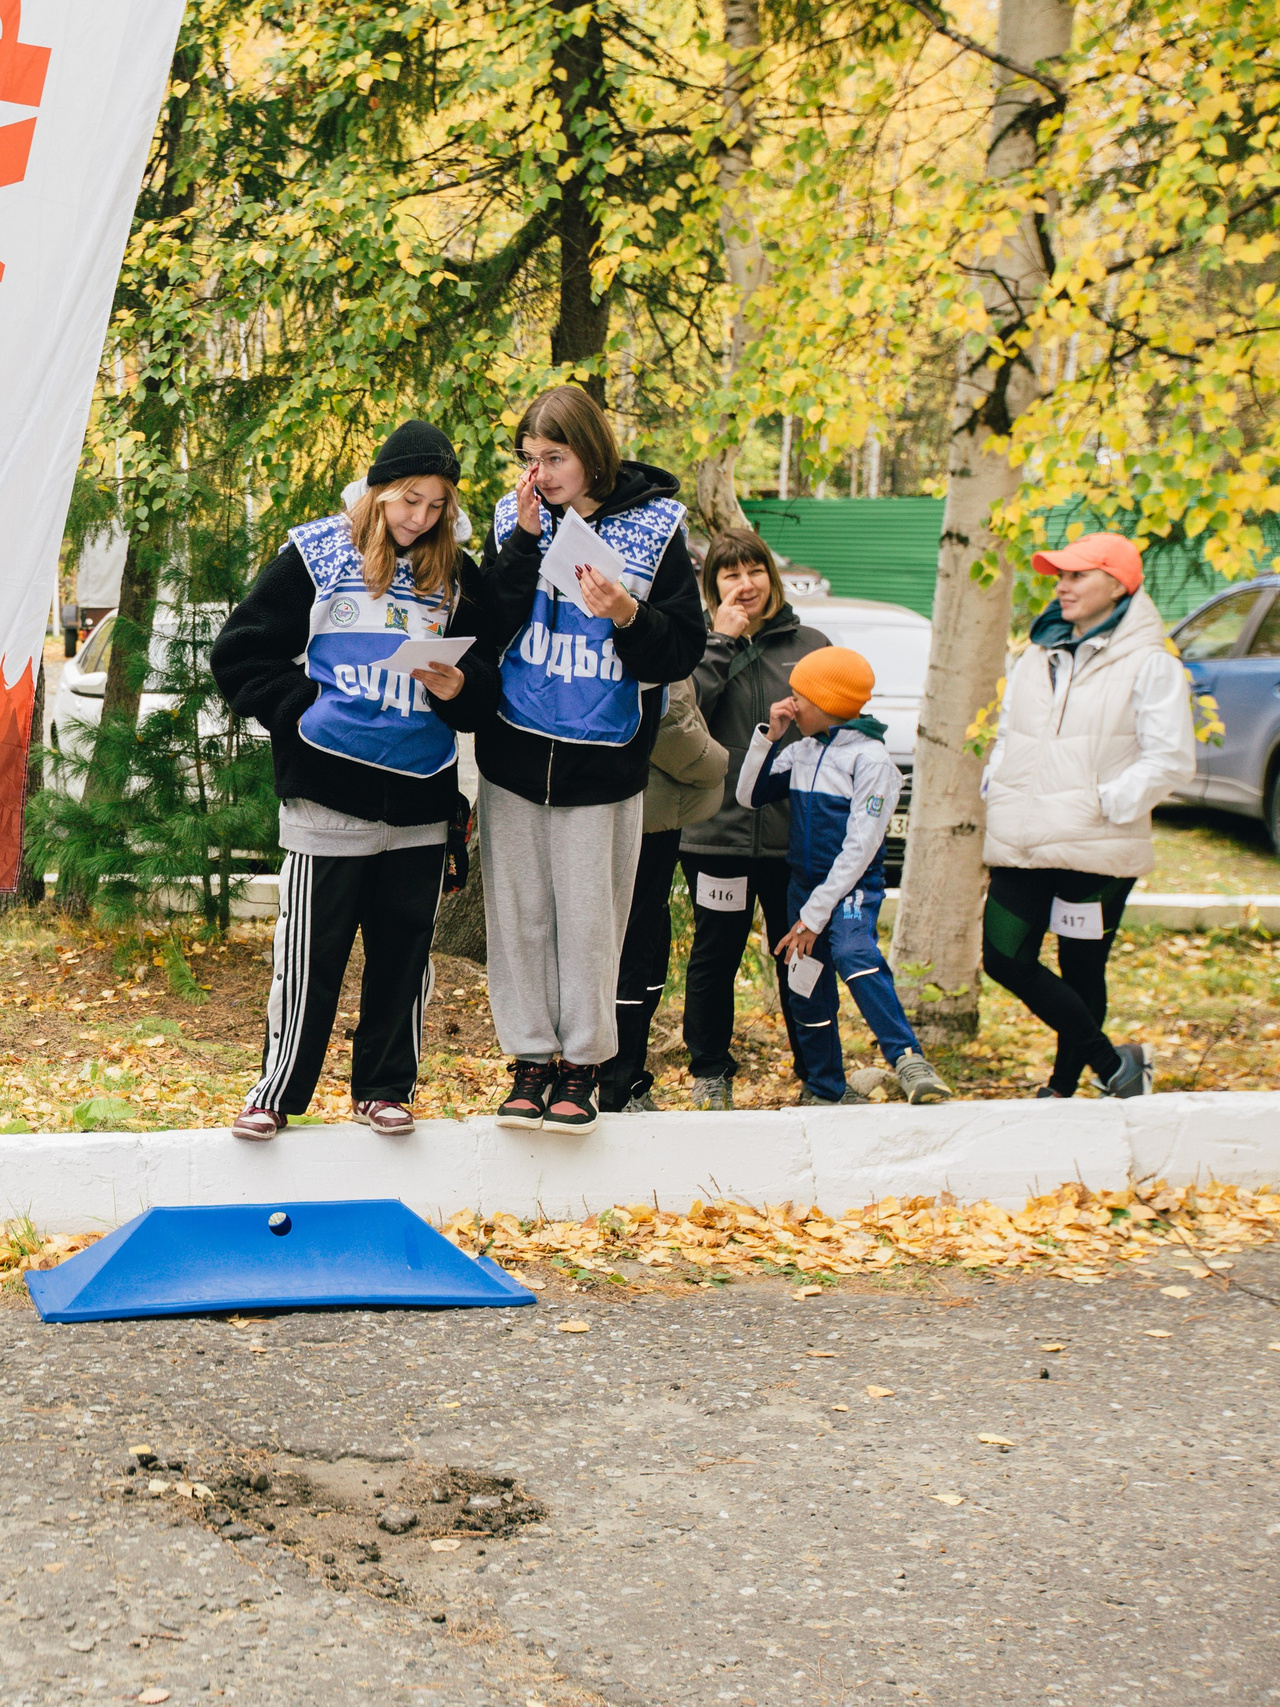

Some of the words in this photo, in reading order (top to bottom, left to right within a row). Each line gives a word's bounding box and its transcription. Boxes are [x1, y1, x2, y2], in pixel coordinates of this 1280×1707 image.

[333, 664, 432, 717] СУДЬ
[708, 888, 734, 902] 416
[1060, 914, 1086, 928] 417
